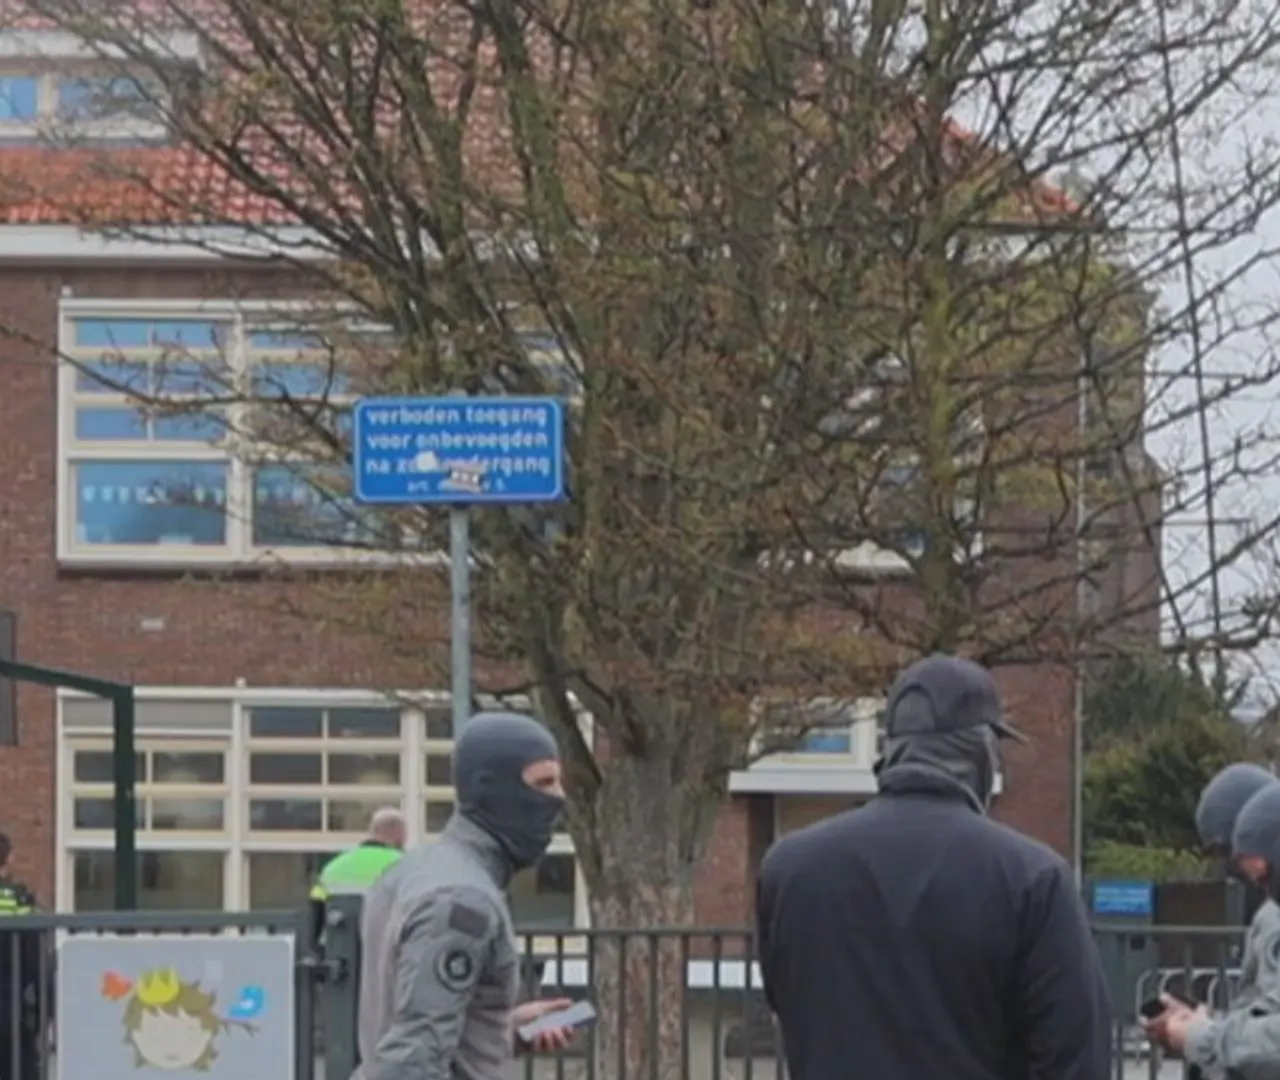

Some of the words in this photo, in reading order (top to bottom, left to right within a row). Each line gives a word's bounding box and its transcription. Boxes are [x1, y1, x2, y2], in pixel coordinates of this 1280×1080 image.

[365, 405, 460, 426] verboden
[465, 406, 548, 428] toegang
[365, 433, 412, 450] voor
[415, 429, 548, 452] onbevoegden
[365, 459, 391, 473] na
[396, 455, 551, 478] zooergang
